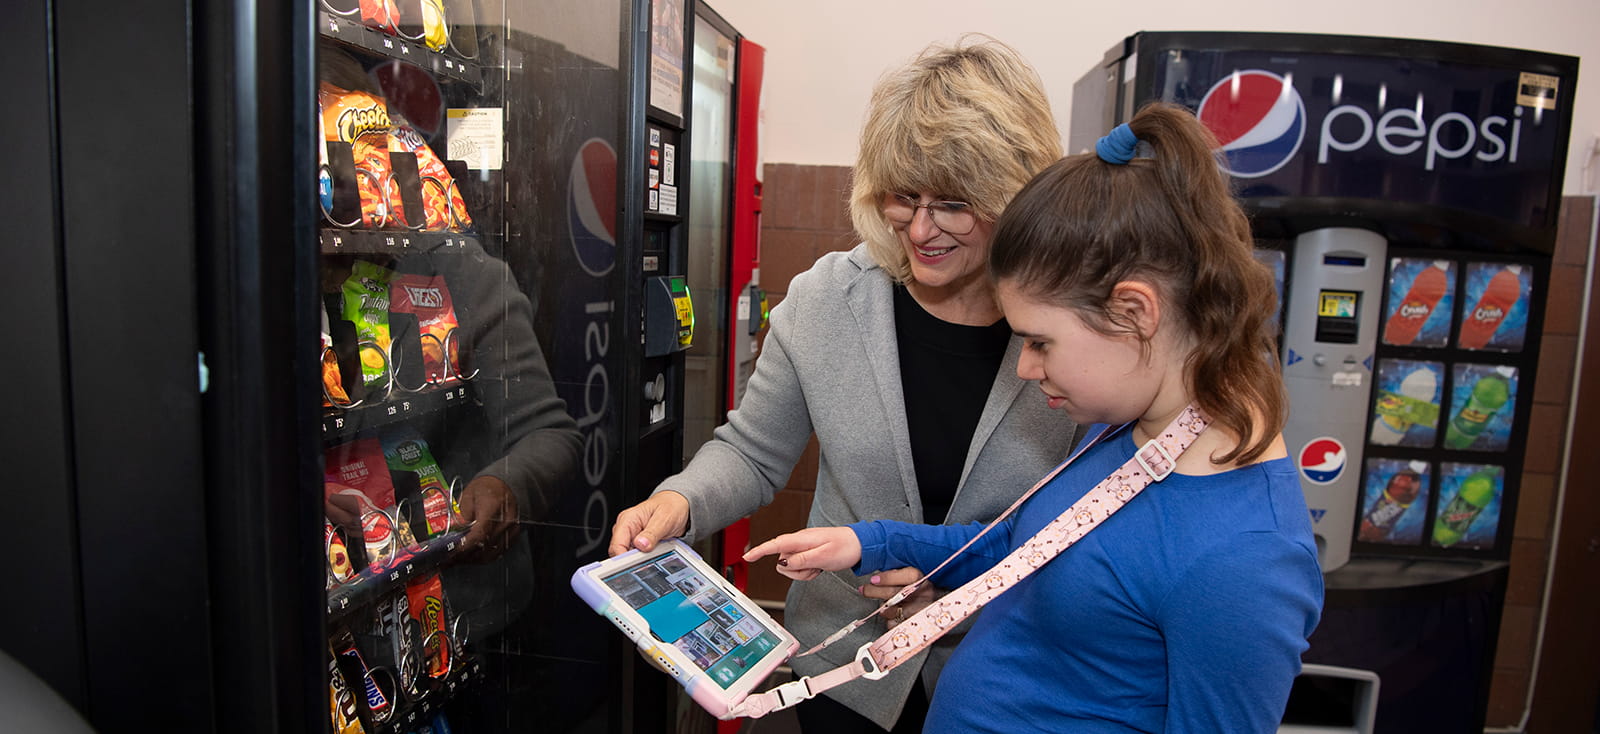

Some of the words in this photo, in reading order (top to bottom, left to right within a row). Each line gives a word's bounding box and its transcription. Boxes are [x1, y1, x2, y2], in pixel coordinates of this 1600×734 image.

[339, 103, 392, 143] Cheeto
[1317, 104, 1524, 171] pepsi
[399, 444, 418, 455] BLACK
[402, 450, 420, 461] FOREST
[340, 461, 366, 473] ORIGINAL
[342, 470, 359, 480] TRAIL
